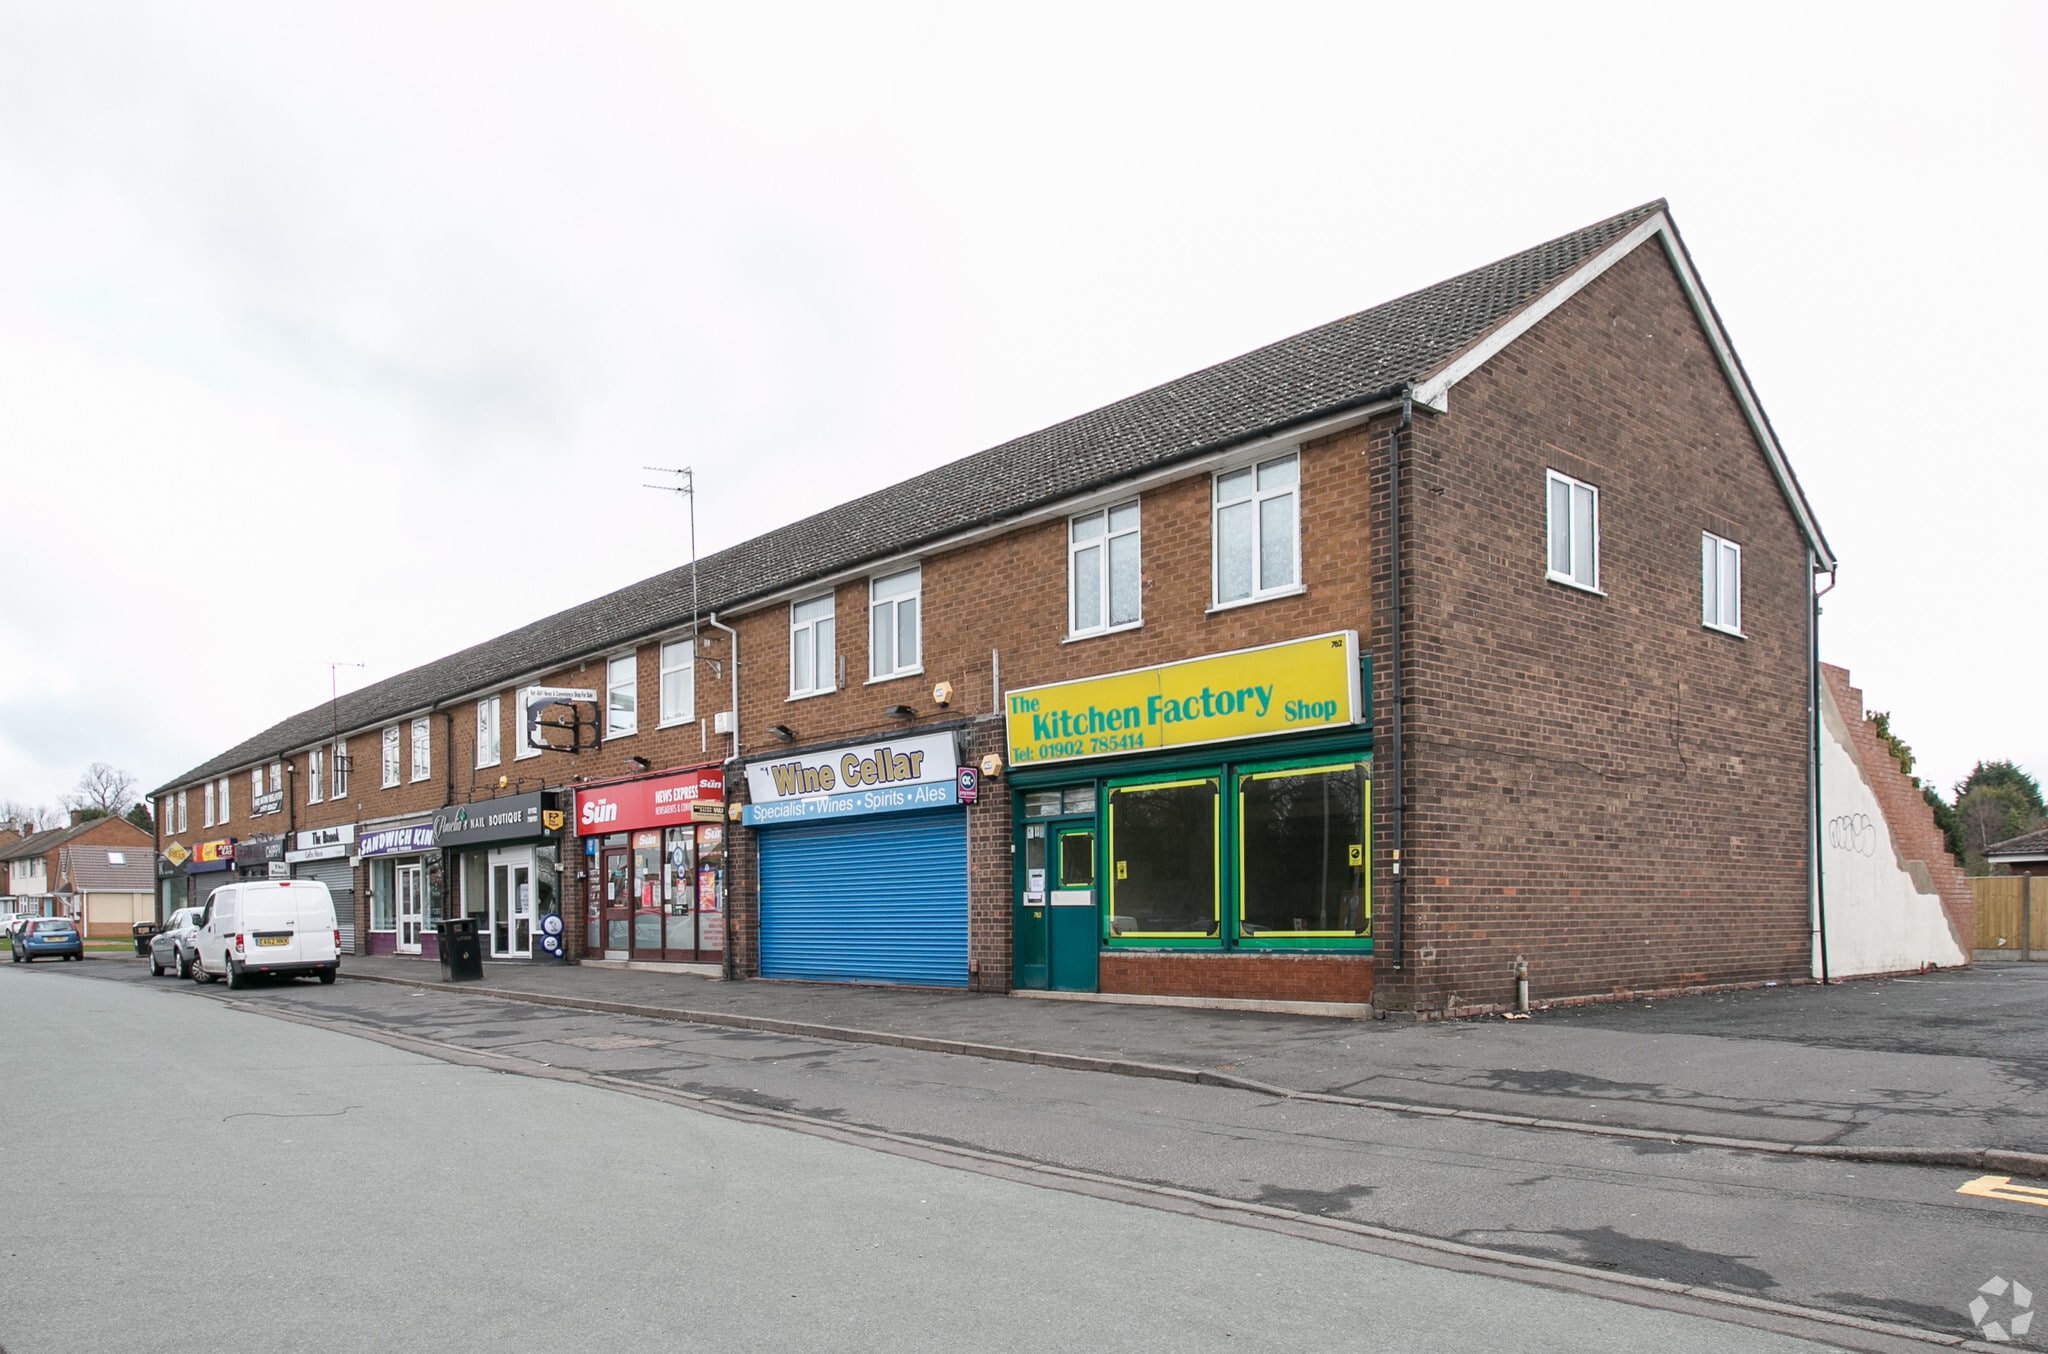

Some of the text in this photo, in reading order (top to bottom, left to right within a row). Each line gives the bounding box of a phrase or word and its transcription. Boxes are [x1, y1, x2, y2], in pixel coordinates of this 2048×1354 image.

[1330, 639, 1343, 648] 762
[1010, 696, 1040, 714] The
[1032, 684, 1337, 741] Kitchen Factory Shop
[1012, 732, 1144, 763] Tel: 01902 785414
[771, 762, 836, 796] Wine
[841, 747, 924, 788] Cellar
[655, 789, 673, 804] NEWS
[753, 786, 946, 822] Specialist Wines Spirits Ales
[470, 818, 485, 829] NAIL
[489, 811, 522, 826] BOUTIQUE
[582, 801, 617, 825] Sun
[312, 831, 321, 845] The
[361, 828, 434, 855] SANDWICH KIN
